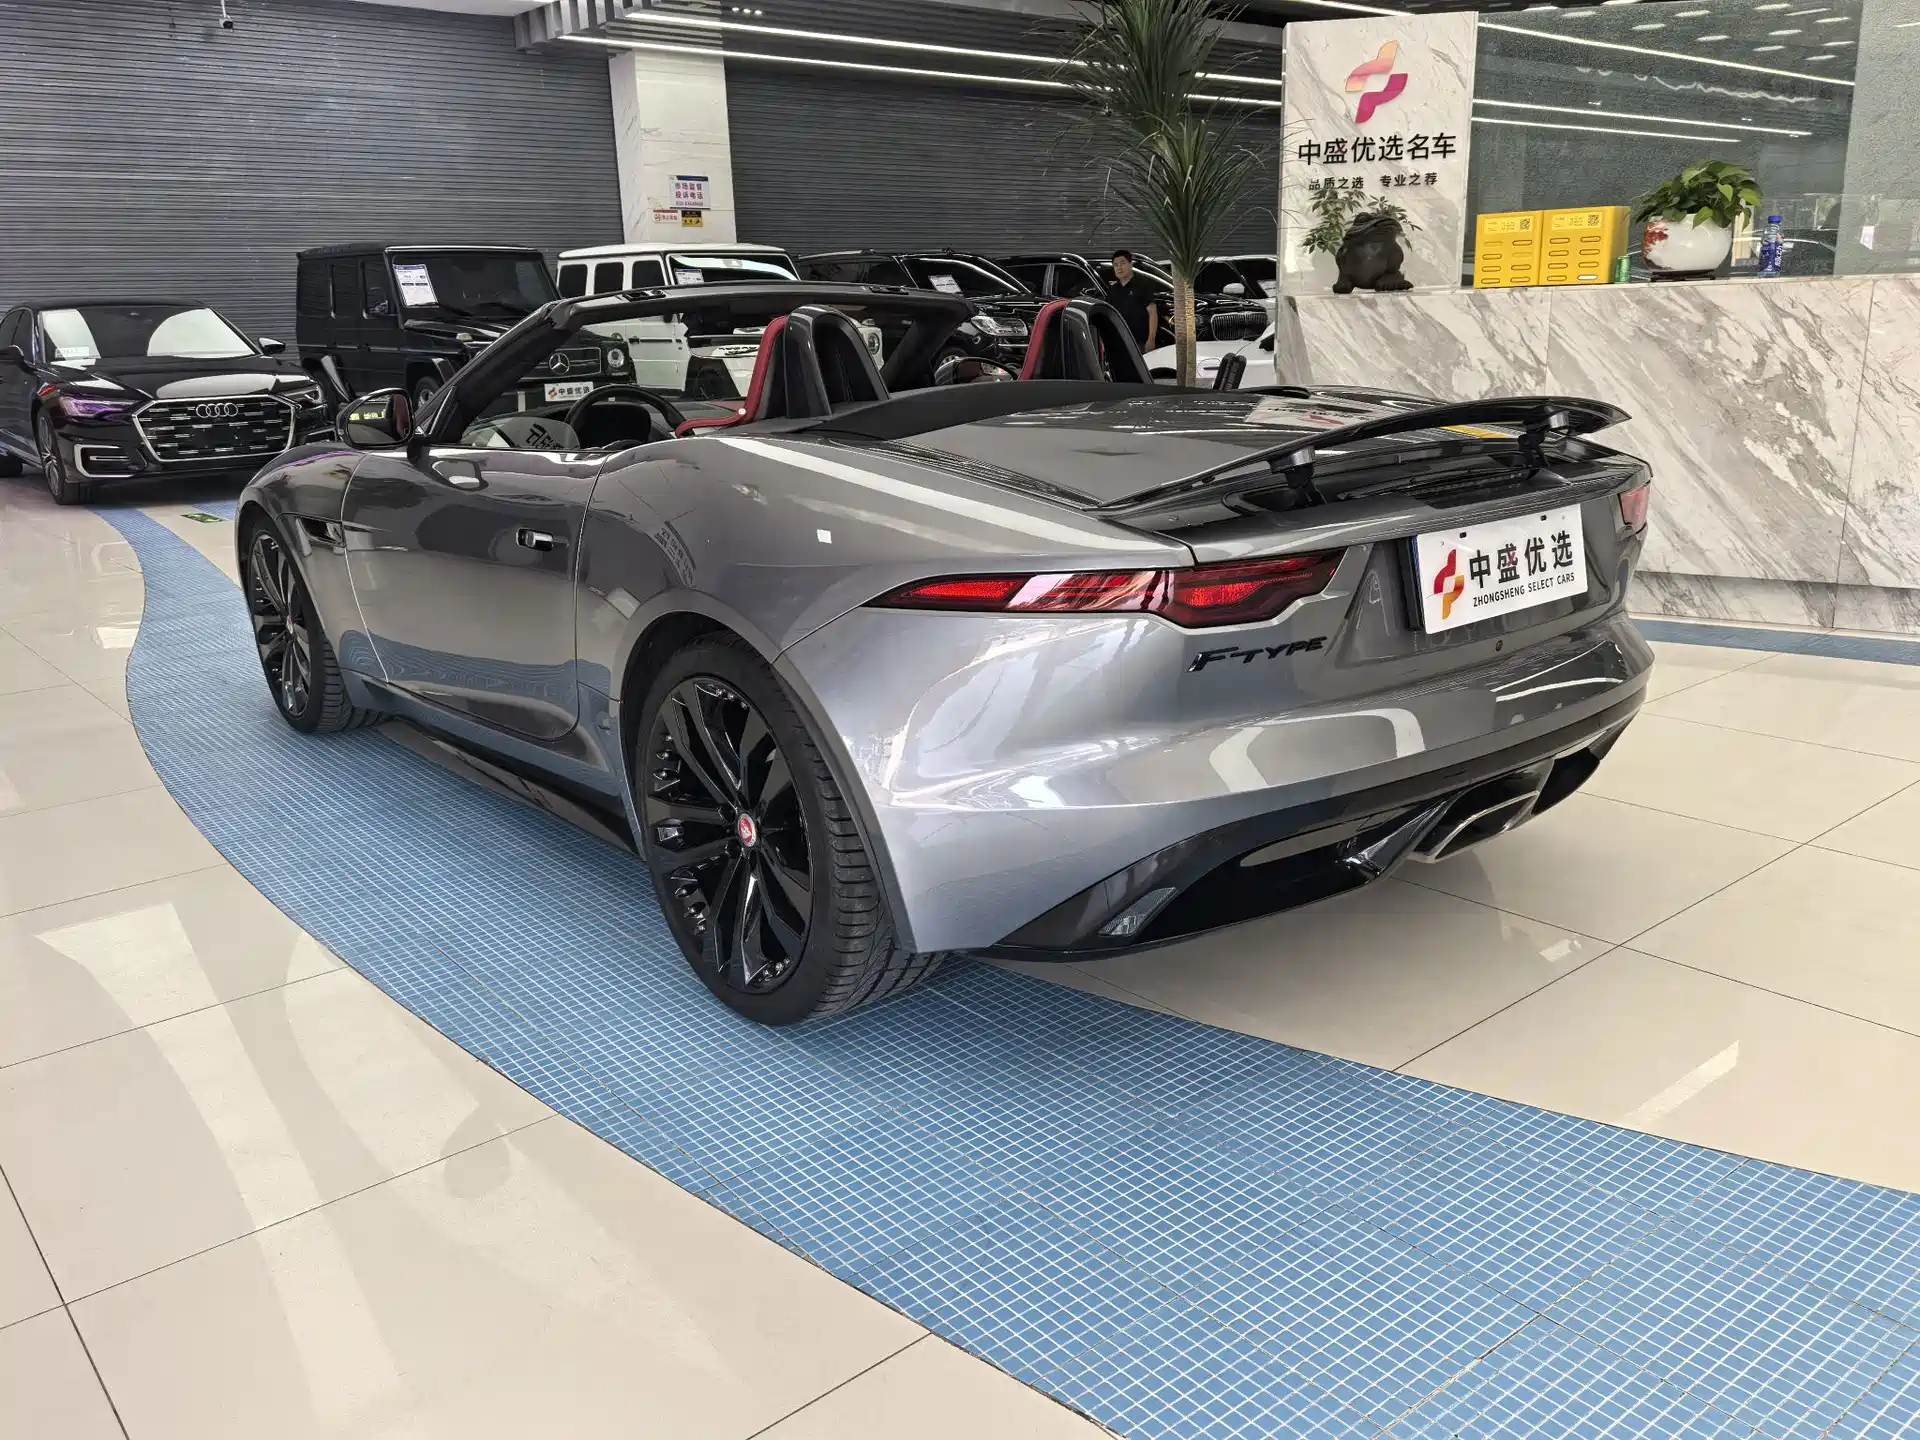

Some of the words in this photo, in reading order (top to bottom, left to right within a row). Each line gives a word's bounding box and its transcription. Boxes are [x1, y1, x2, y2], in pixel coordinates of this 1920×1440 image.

[1298, 132, 1457, 166] 中盛优选名车
[675, 182, 702, 191] 市场监督
[1308, 176, 1365, 191] 品质之选
[1379, 172, 1438, 188] 专业之荐
[675, 191, 703, 200] 投诉电话
[558, 386, 590, 396] 中盛优选
[1469, 530, 1574, 589] 中盛优选
[1472, 585, 1526, 608] ZHONGSHENG
[1528, 577, 1554, 592] SELECT
[1556, 572, 1575, 585] CARS
[1187, 636, 1328, 672] F-TYPE
